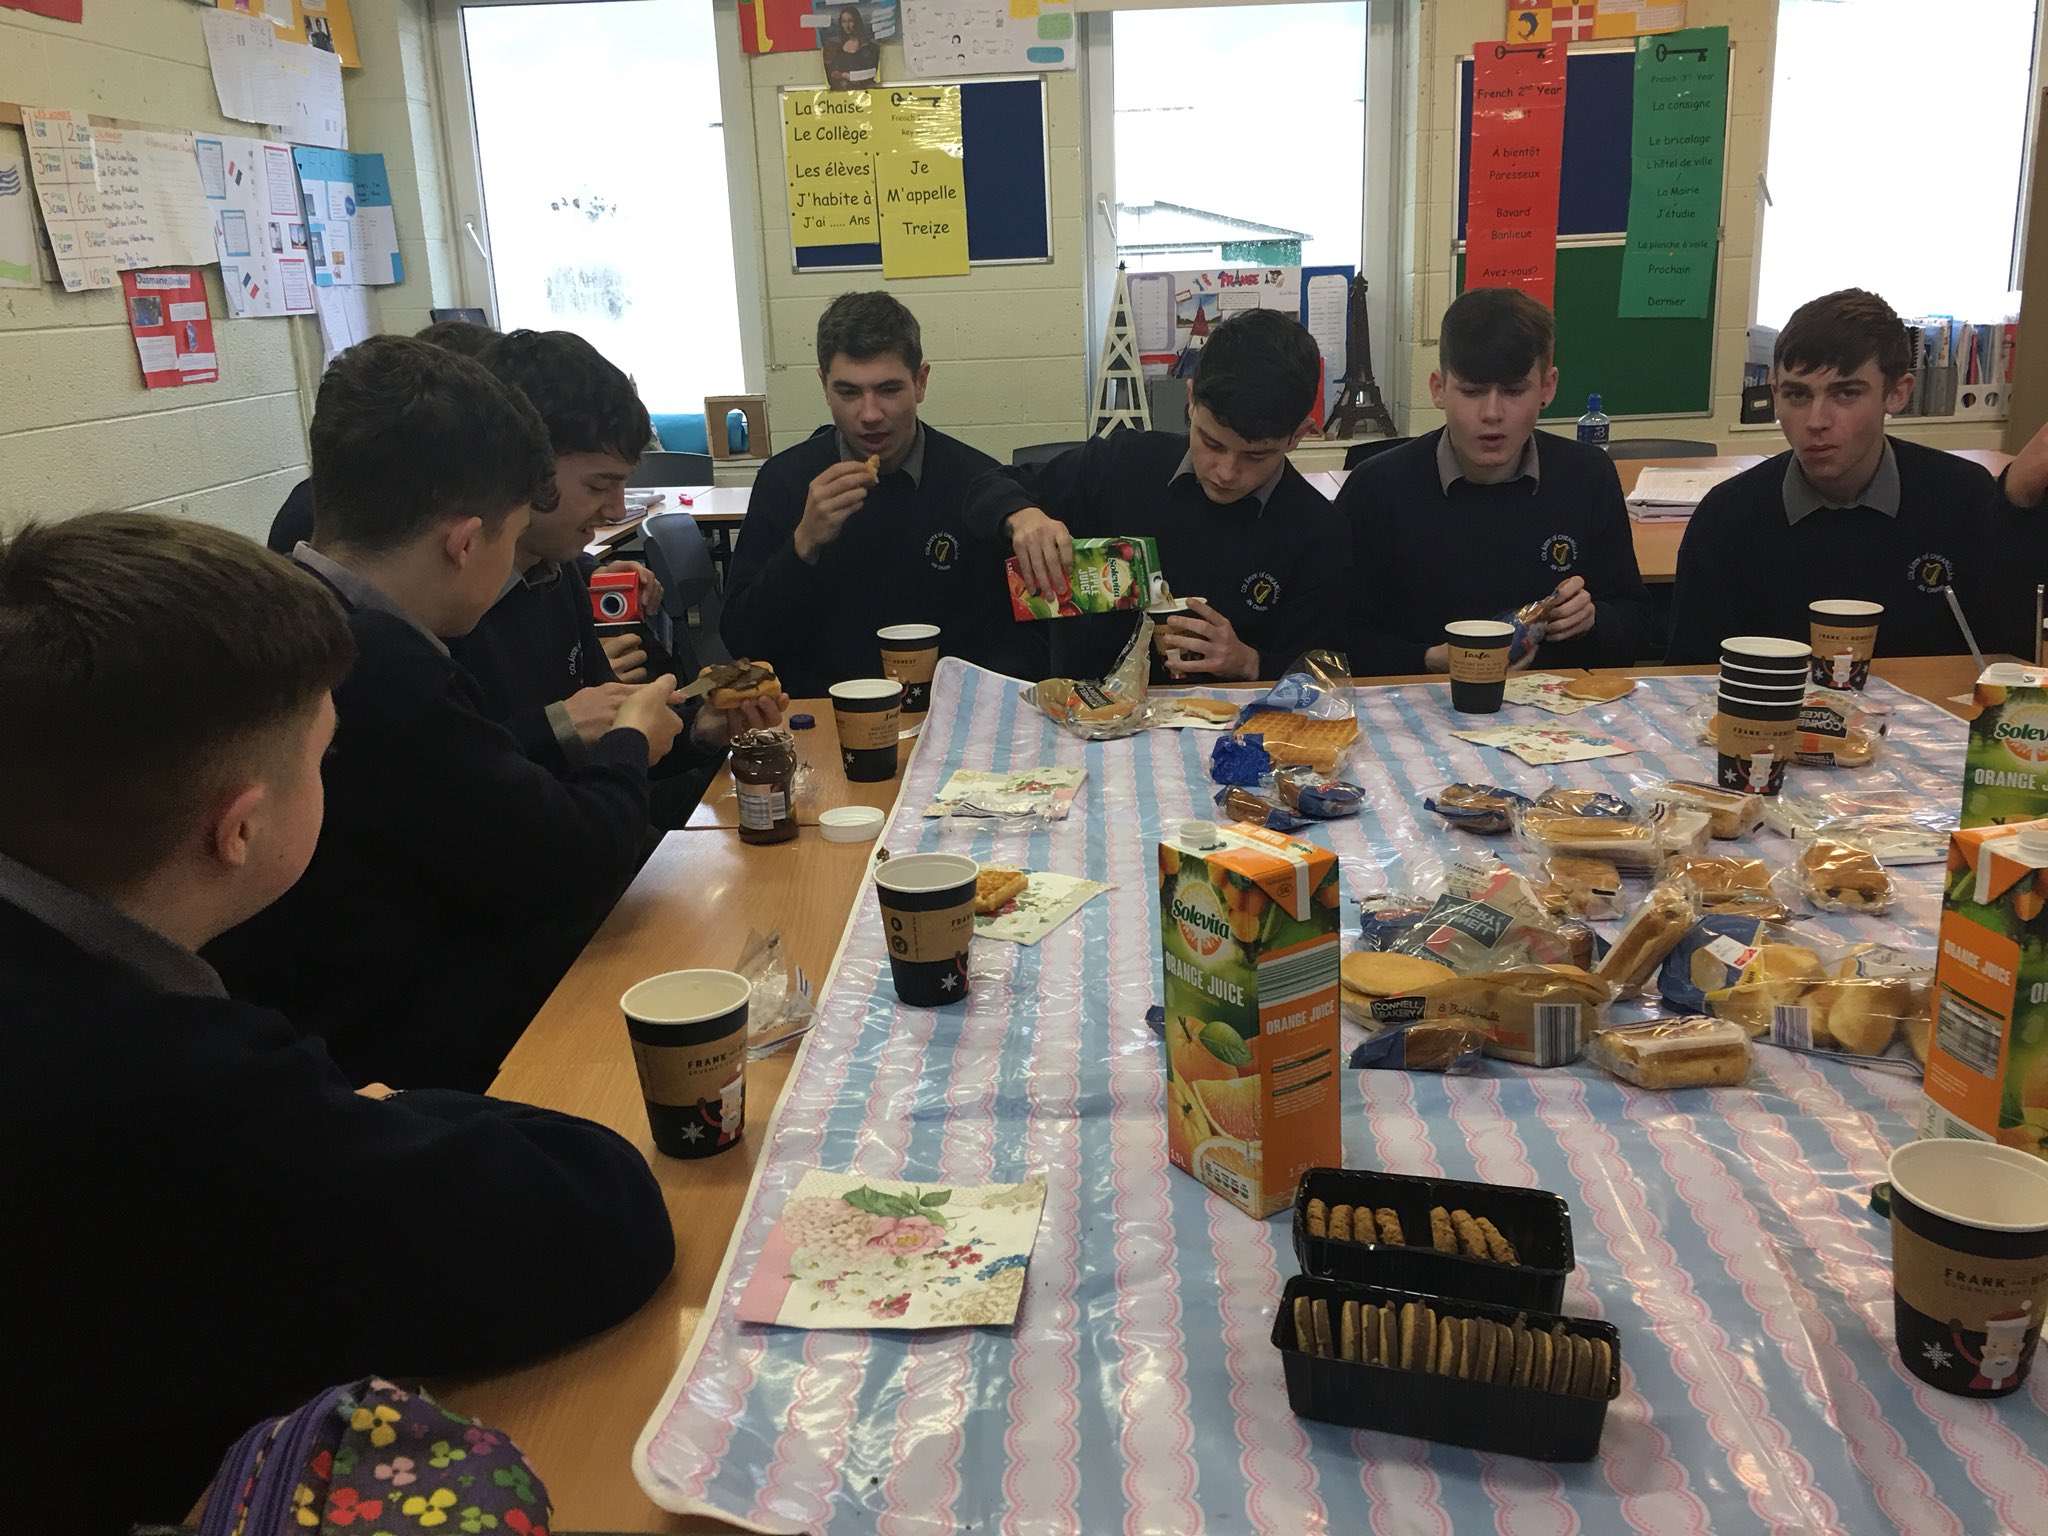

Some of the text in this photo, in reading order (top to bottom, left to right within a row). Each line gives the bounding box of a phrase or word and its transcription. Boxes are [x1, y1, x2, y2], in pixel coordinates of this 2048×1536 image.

[1651, 74, 1678, 84] French
[1698, 73, 1715, 81] Year
[1478, 87, 1513, 99] French
[1537, 86, 1562, 96] Year
[795, 100, 864, 116] La Chaise
[1653, 99, 1711, 112] La consigne
[891, 114, 916, 122] French
[794, 126, 868, 144] Le Collège
[901, 128, 915, 137] key
[1649, 134, 1711, 148] Le bricolage
[1503, 146, 1540, 157] bientôt
[796, 161, 870, 178] Les élèves
[910, 160, 929, 175] Je
[1647, 157, 1713, 169] L'hôtel de ville
[1489, 170, 1540, 180] Paresseux
[887, 186, 957, 205] M'appelle
[1657, 186, 1700, 196] La Mairie
[797, 193, 872, 208] J'habite à
[1496, 207, 1531, 218] Bavard
[1656, 208, 1696, 219] J'étudie
[803, 216, 827, 229] J'ai
[849, 214, 870, 227] Ans
[903, 221, 950, 236] Treize
[1491, 229, 1532, 240] Banlieue
[1638, 241, 1650, 250] La
[1651, 241, 1681, 251] planche
[1691, 240, 1709, 249] voile
[1482, 266, 1538, 278] Avez-vous?
[1648, 265, 1691, 275] Prochain
[1648, 296, 1686, 307] Dernier
[1078, 569, 1091, 596] JUICE
[1087, 566, 1100, 596] APPLE
[1108, 557, 1120, 598] Solevita
[1464, 651, 1490, 660] Santa
[1733, 728, 1760, 736] FRANK
[1798, 719, 1842, 732] CONNE
[1997, 722, 2048, 741] Solev
[1974, 768, 2037, 790] ORANGE
[1173, 899, 1229, 939] Solevita
[1165, 951, 1245, 1007] ORANGE JUICE
[1374, 1000, 1420, 1012] CONNELL
[1266, 1000, 1335, 1036] ORANGE JUICE
[1378, 1009, 1417, 1019] BAKERY
[687, 1052, 727, 1069] FRANK
[1945, 1267, 2006, 1289] FRANK
